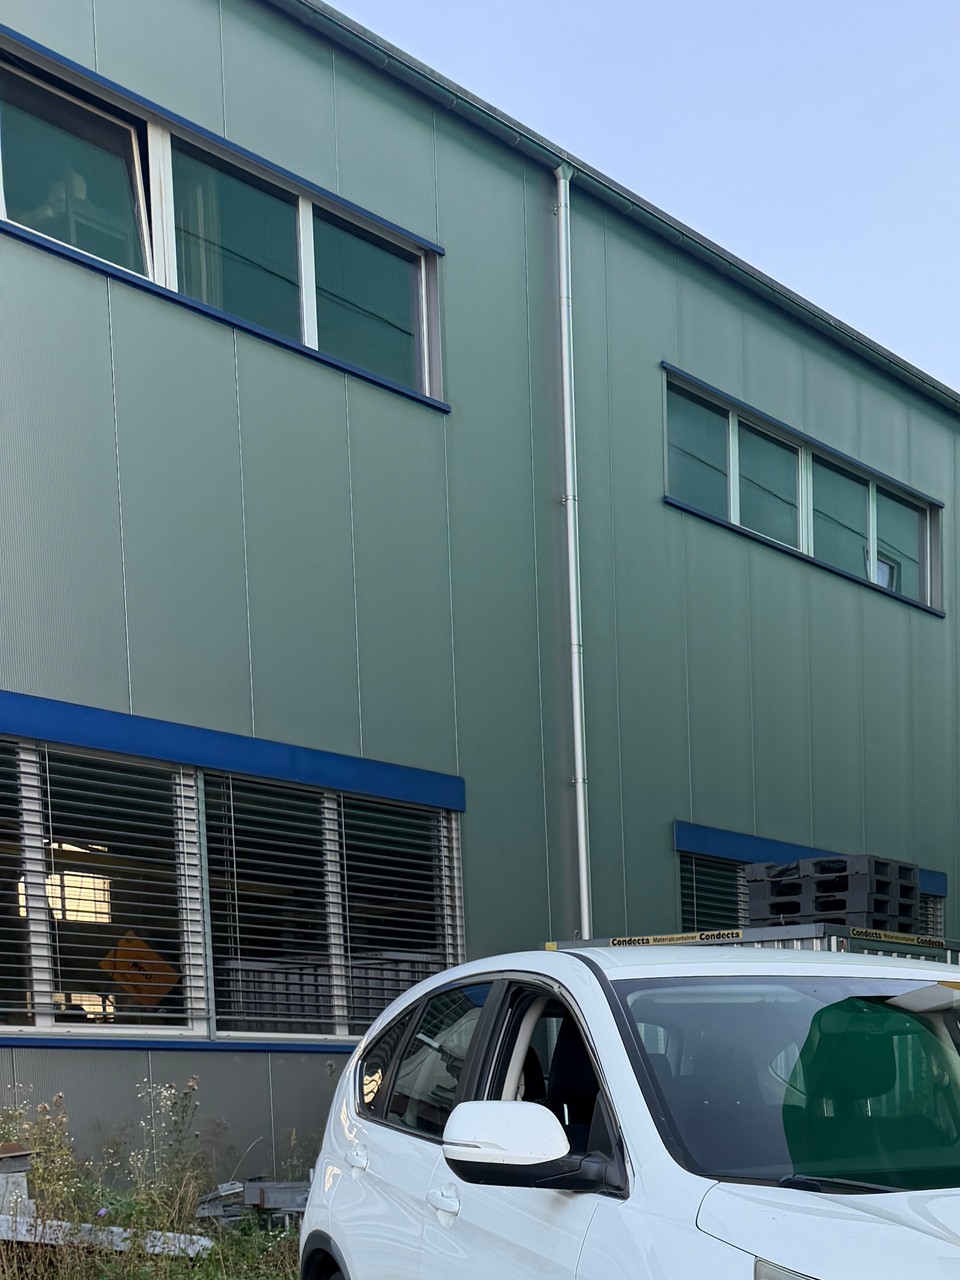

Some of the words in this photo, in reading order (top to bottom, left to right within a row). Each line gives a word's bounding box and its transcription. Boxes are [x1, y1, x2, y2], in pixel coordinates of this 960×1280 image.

[611, 937, 650, 947] Condecta
[699, 930, 740, 941] Condecta
[851, 928, 882, 939] Condecta
[916, 937, 944, 947] Condecta
